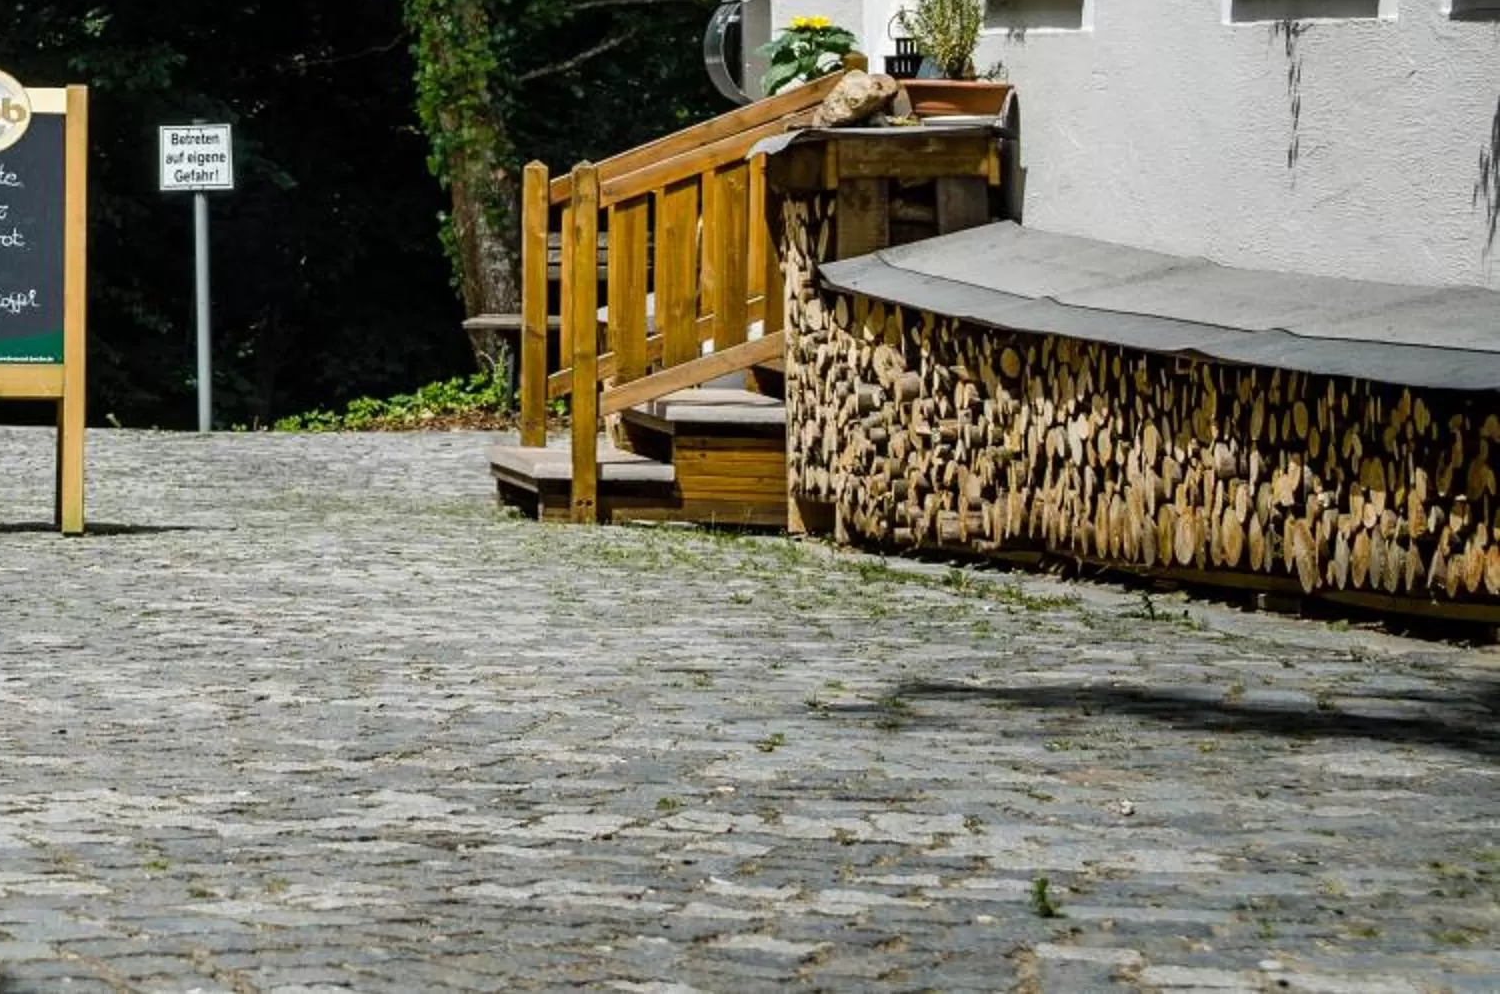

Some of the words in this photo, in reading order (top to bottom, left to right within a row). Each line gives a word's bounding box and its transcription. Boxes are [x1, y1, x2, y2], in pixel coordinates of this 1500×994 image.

[171, 132, 220, 146] Betreten
[165, 150, 184, 165] auf
[187, 151, 226, 167] eigene
[173, 169, 219, 183] Gefahr!
